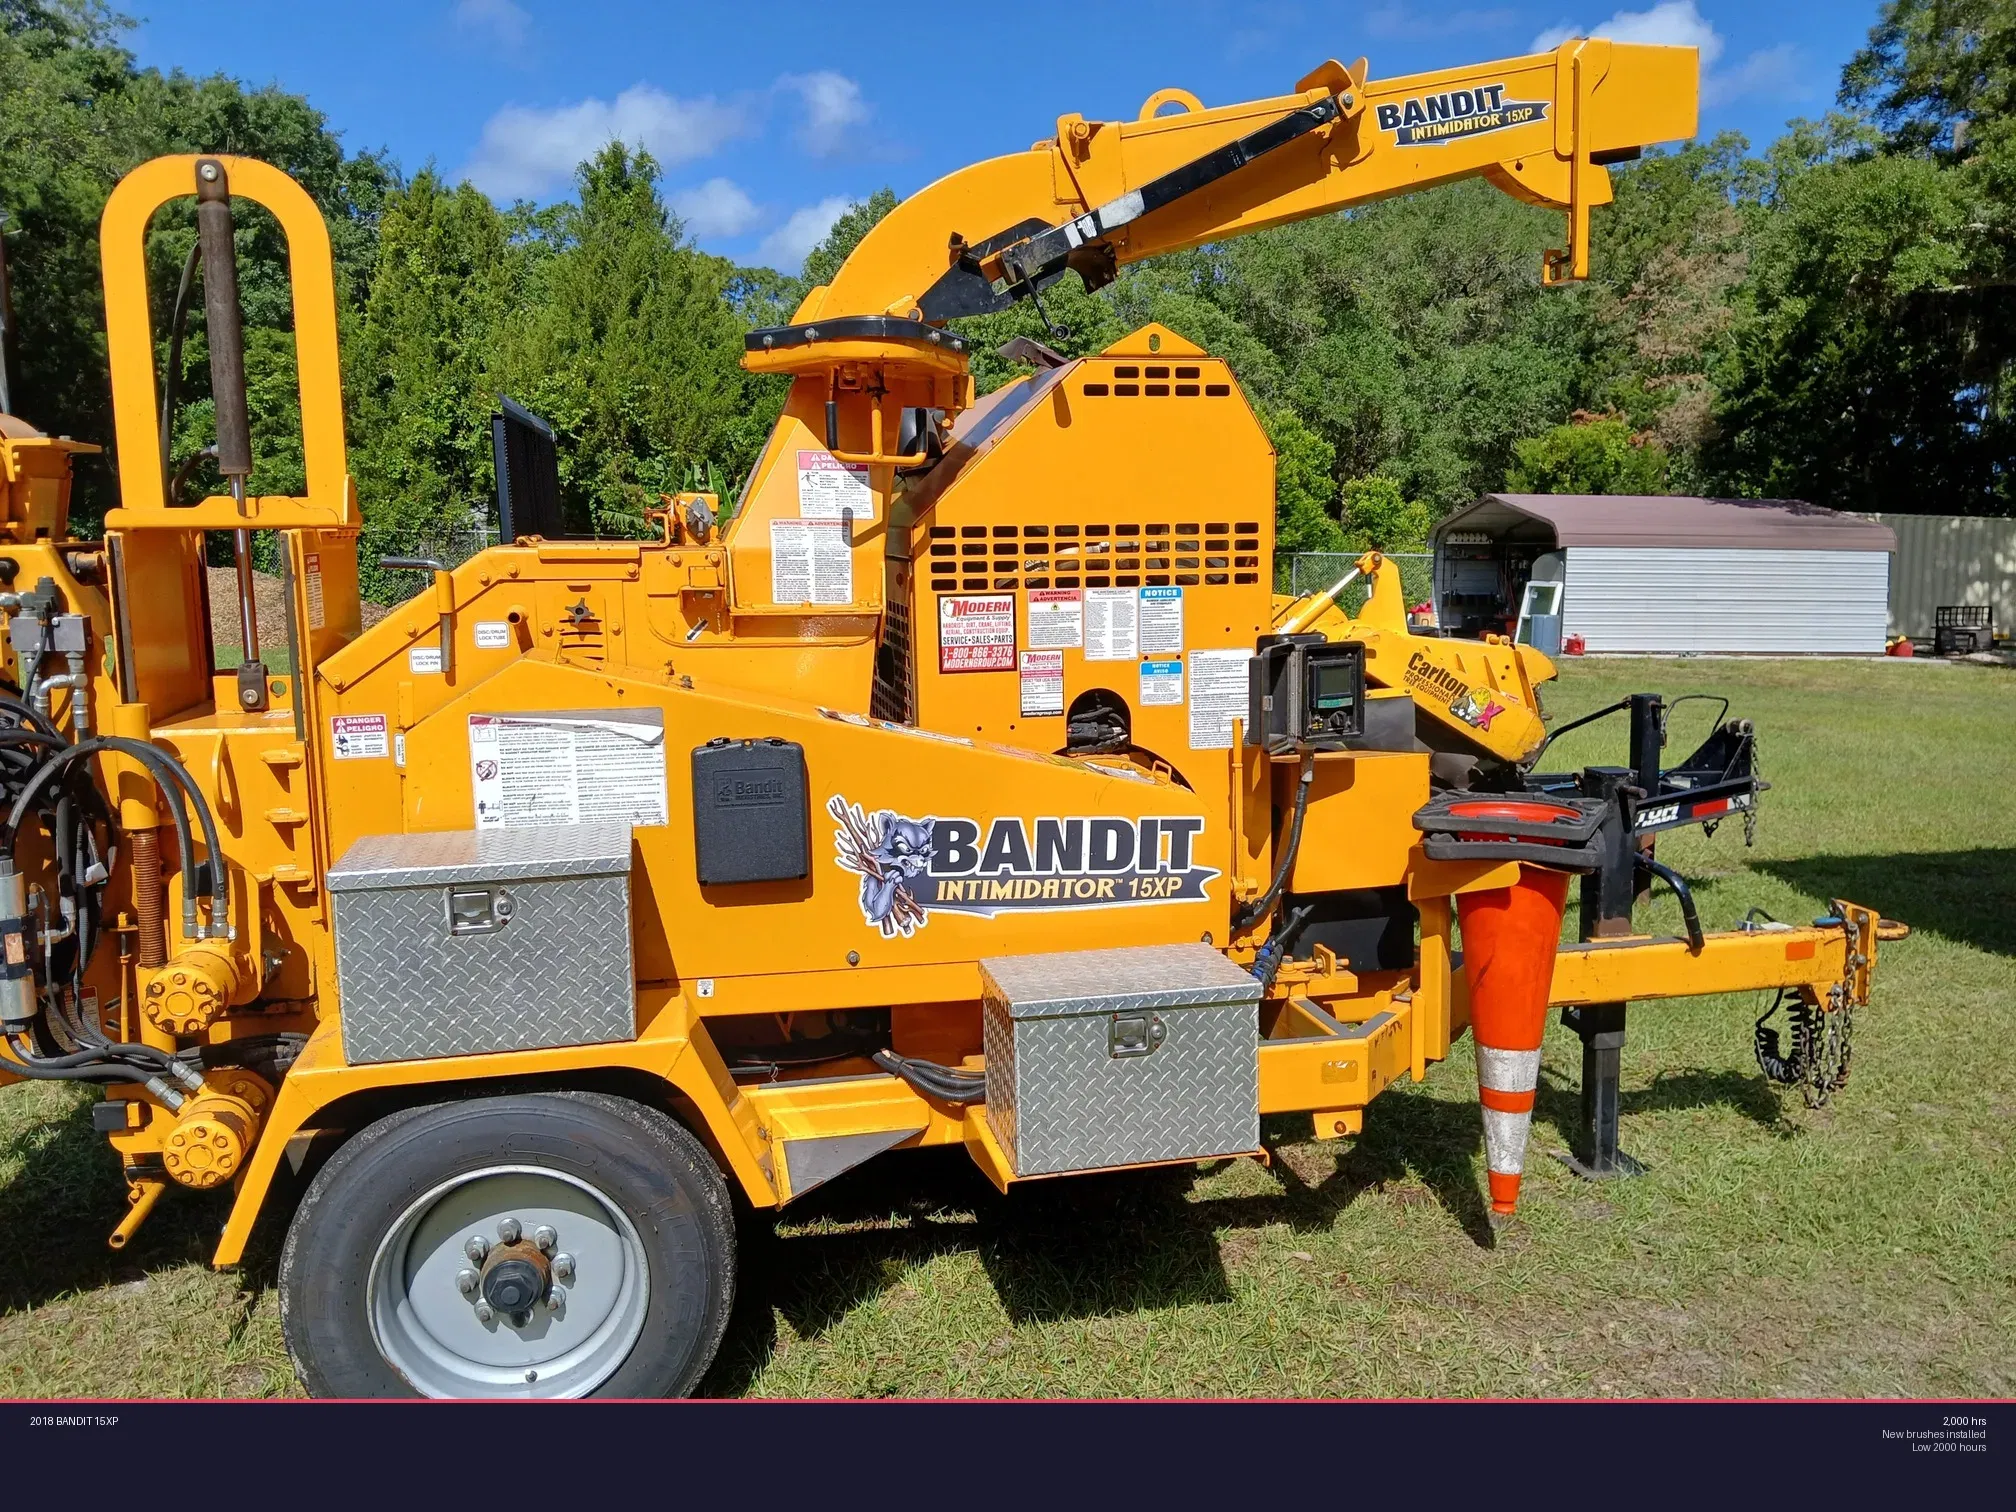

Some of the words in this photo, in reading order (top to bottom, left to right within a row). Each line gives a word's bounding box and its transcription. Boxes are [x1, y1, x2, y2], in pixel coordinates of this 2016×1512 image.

[1377, 84, 1504, 130] BANDIT
[1506, 107, 1533, 123] 15XP
[952, 600, 1011, 617] MODERN
[943, 647, 1013, 660] 1-800-866-3376
[943, 657, 1014, 669] MODERNGROUP.COM
[1027, 654, 1061, 663] MODERN
[1407, 652, 1469, 698] Carlton
[1405, 669, 1456, 701] PROFESSIONAL
[1415, 683, 1450, 705] EQUIPMENT
[735, 779, 782, 795] Bandit
[931, 819, 1202, 873] BANDIT
[1128, 876, 1182, 898] 15XP
